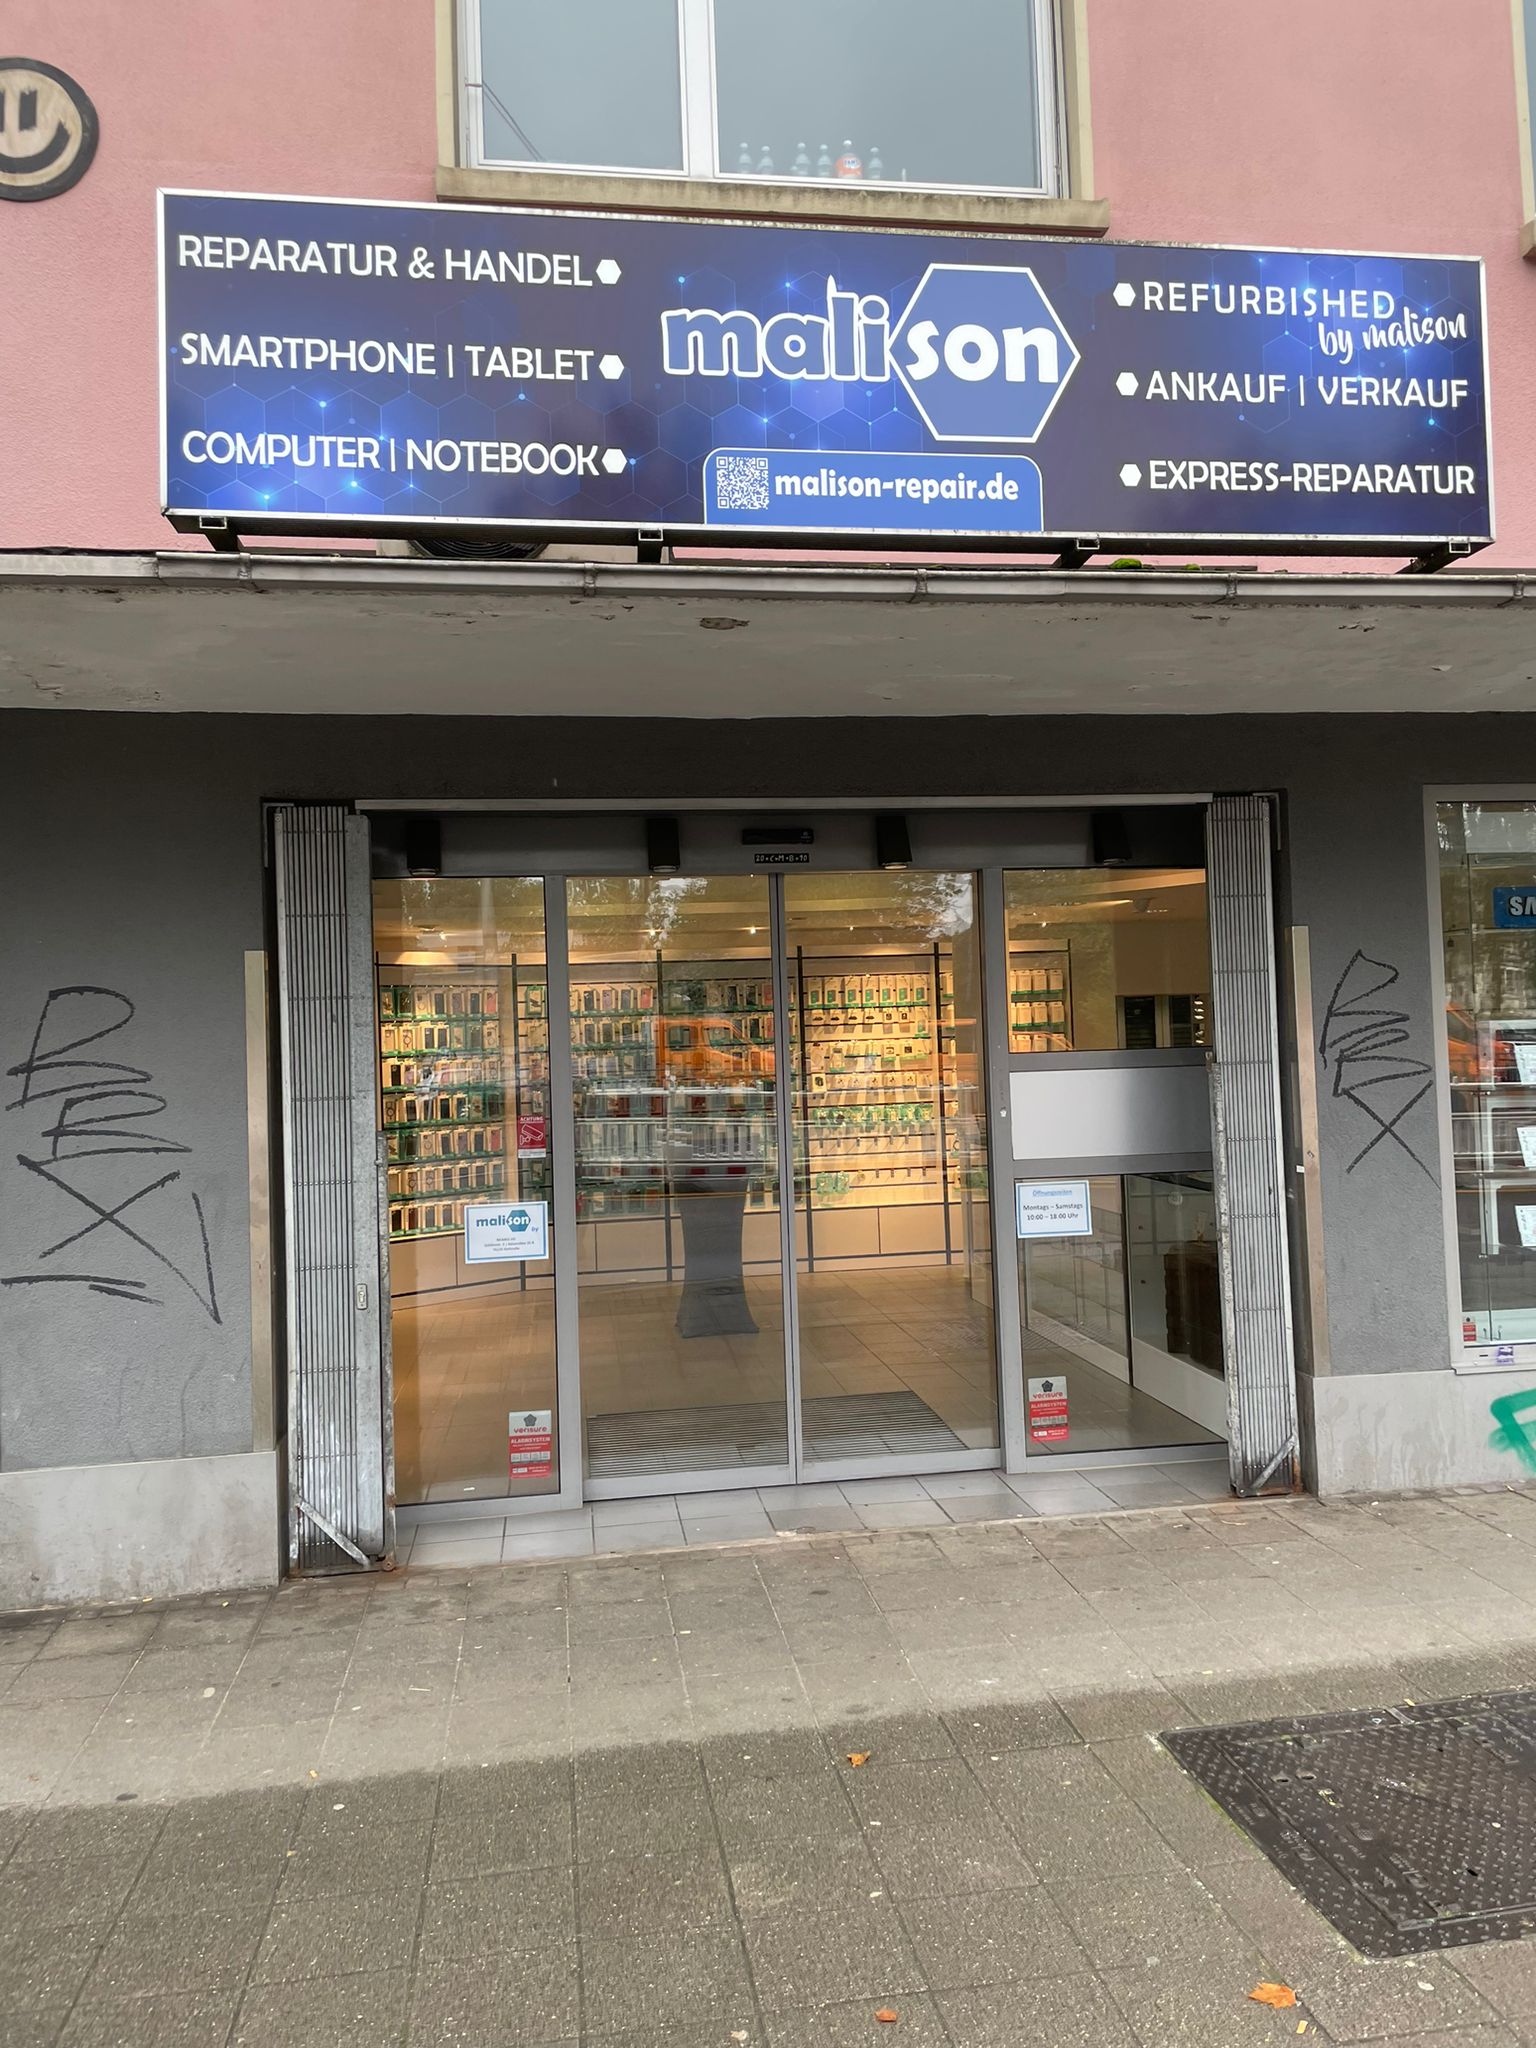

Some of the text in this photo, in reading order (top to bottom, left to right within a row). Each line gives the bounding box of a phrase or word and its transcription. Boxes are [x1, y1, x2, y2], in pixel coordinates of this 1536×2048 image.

[177, 234, 593, 287] REPARATUR & HANDEL
[1143, 281, 1396, 319] REFURBISHED
[660, 274, 1060, 383] malison
[1318, 306, 1469, 364] by malison
[180, 333, 437, 376] SMARTPHONE
[465, 345, 595, 381] TABLET
[1145, 369, 1288, 404] ANKAUF
[1318, 375, 1470, 408] VERKAUF
[182, 429, 381, 470] COMPUTER
[406, 437, 601, 477] NOTEBOOK
[774, 468, 1020, 504] malison-repair.de
[1149, 460, 1476, 495] EXPRESS-REPARATUR
[476, 1215, 530, 1227] malison
[1032, 1391, 1064, 1399] verisure
[513, 1426, 548, 1434] verisure
